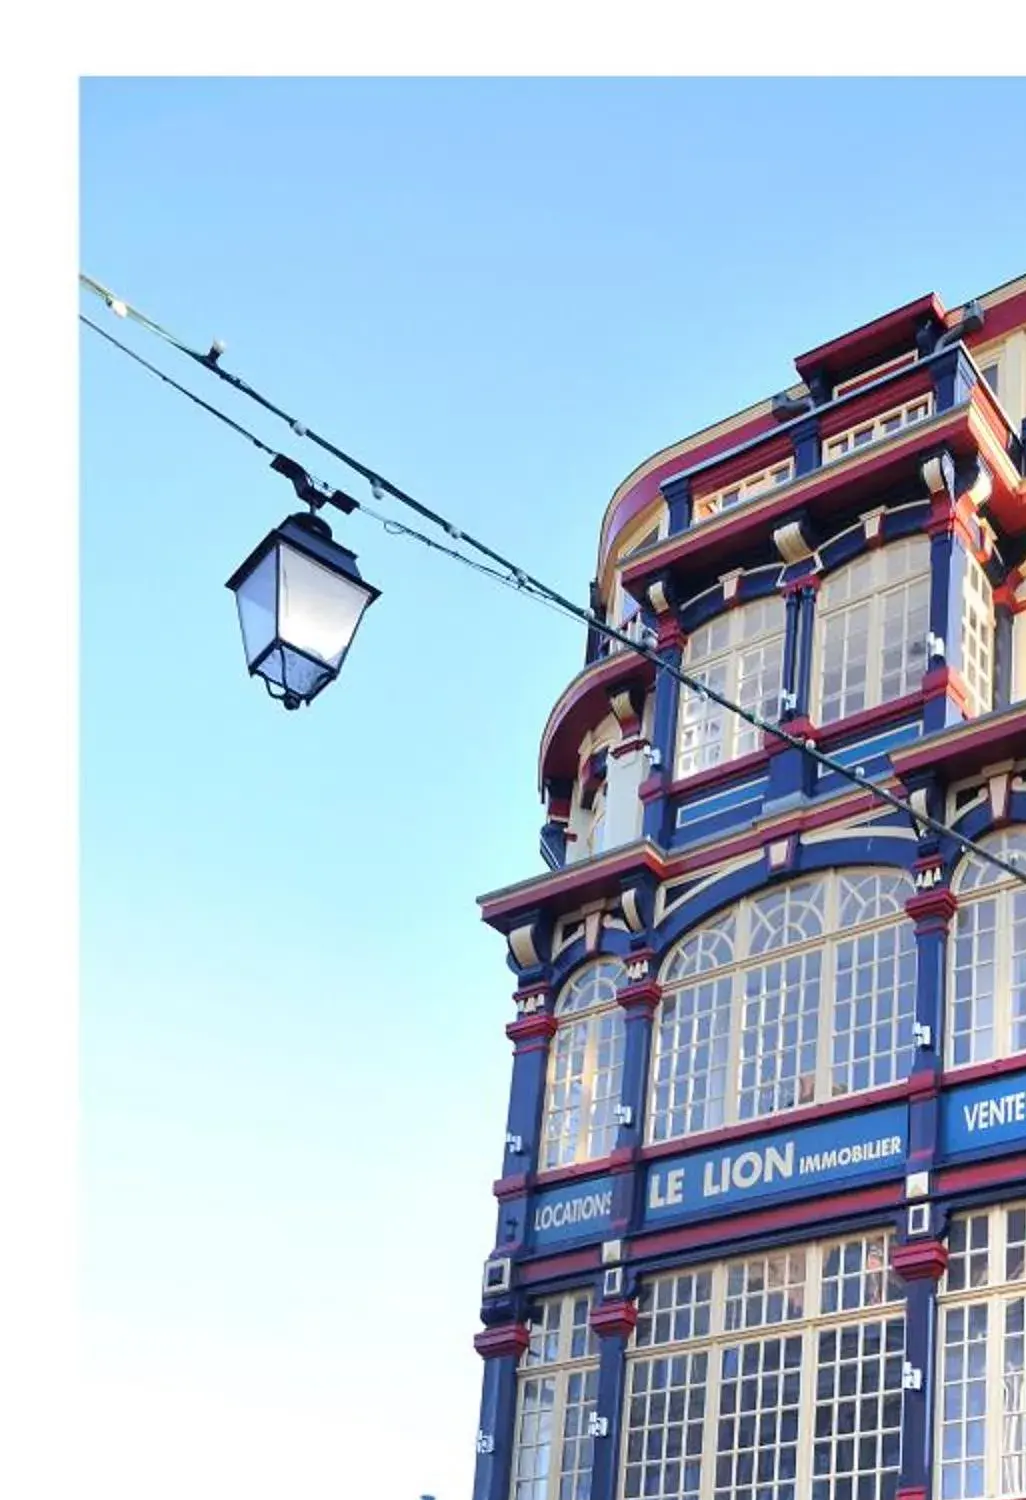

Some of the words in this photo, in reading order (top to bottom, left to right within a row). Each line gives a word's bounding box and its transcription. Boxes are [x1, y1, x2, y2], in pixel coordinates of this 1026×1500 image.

[649, 1168, 685, 1208] LE
[703, 1142, 794, 1197] LION
[800, 1136, 901, 1175] IMMOBILIER
[534, 1191, 613, 1231] LOCATIONS
